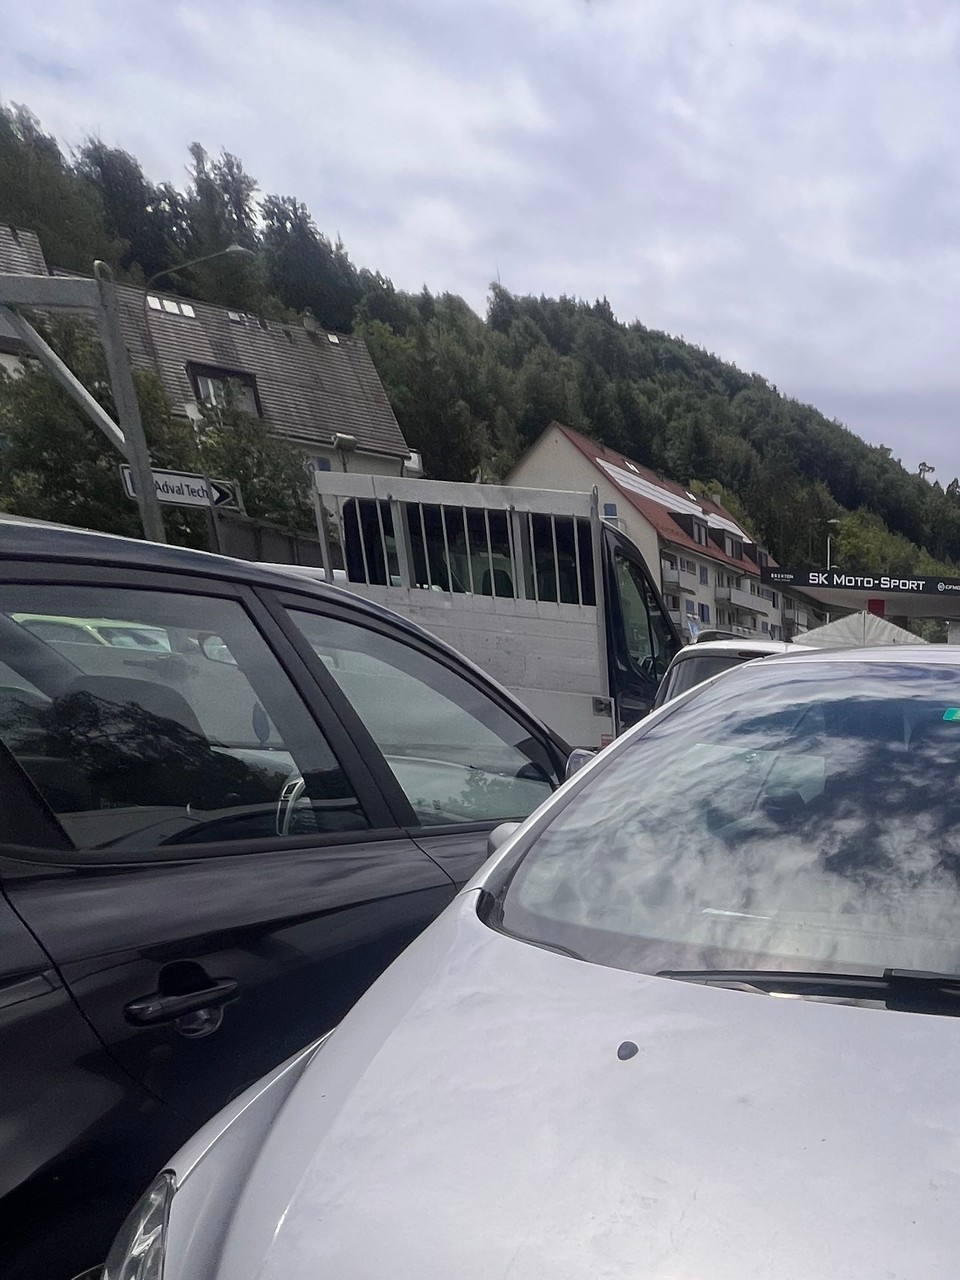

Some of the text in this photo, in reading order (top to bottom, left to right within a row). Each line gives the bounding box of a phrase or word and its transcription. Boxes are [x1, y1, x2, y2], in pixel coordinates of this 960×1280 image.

[154, 480, 209, 499] Adval Tech
[809, 572, 829, 585] SK
